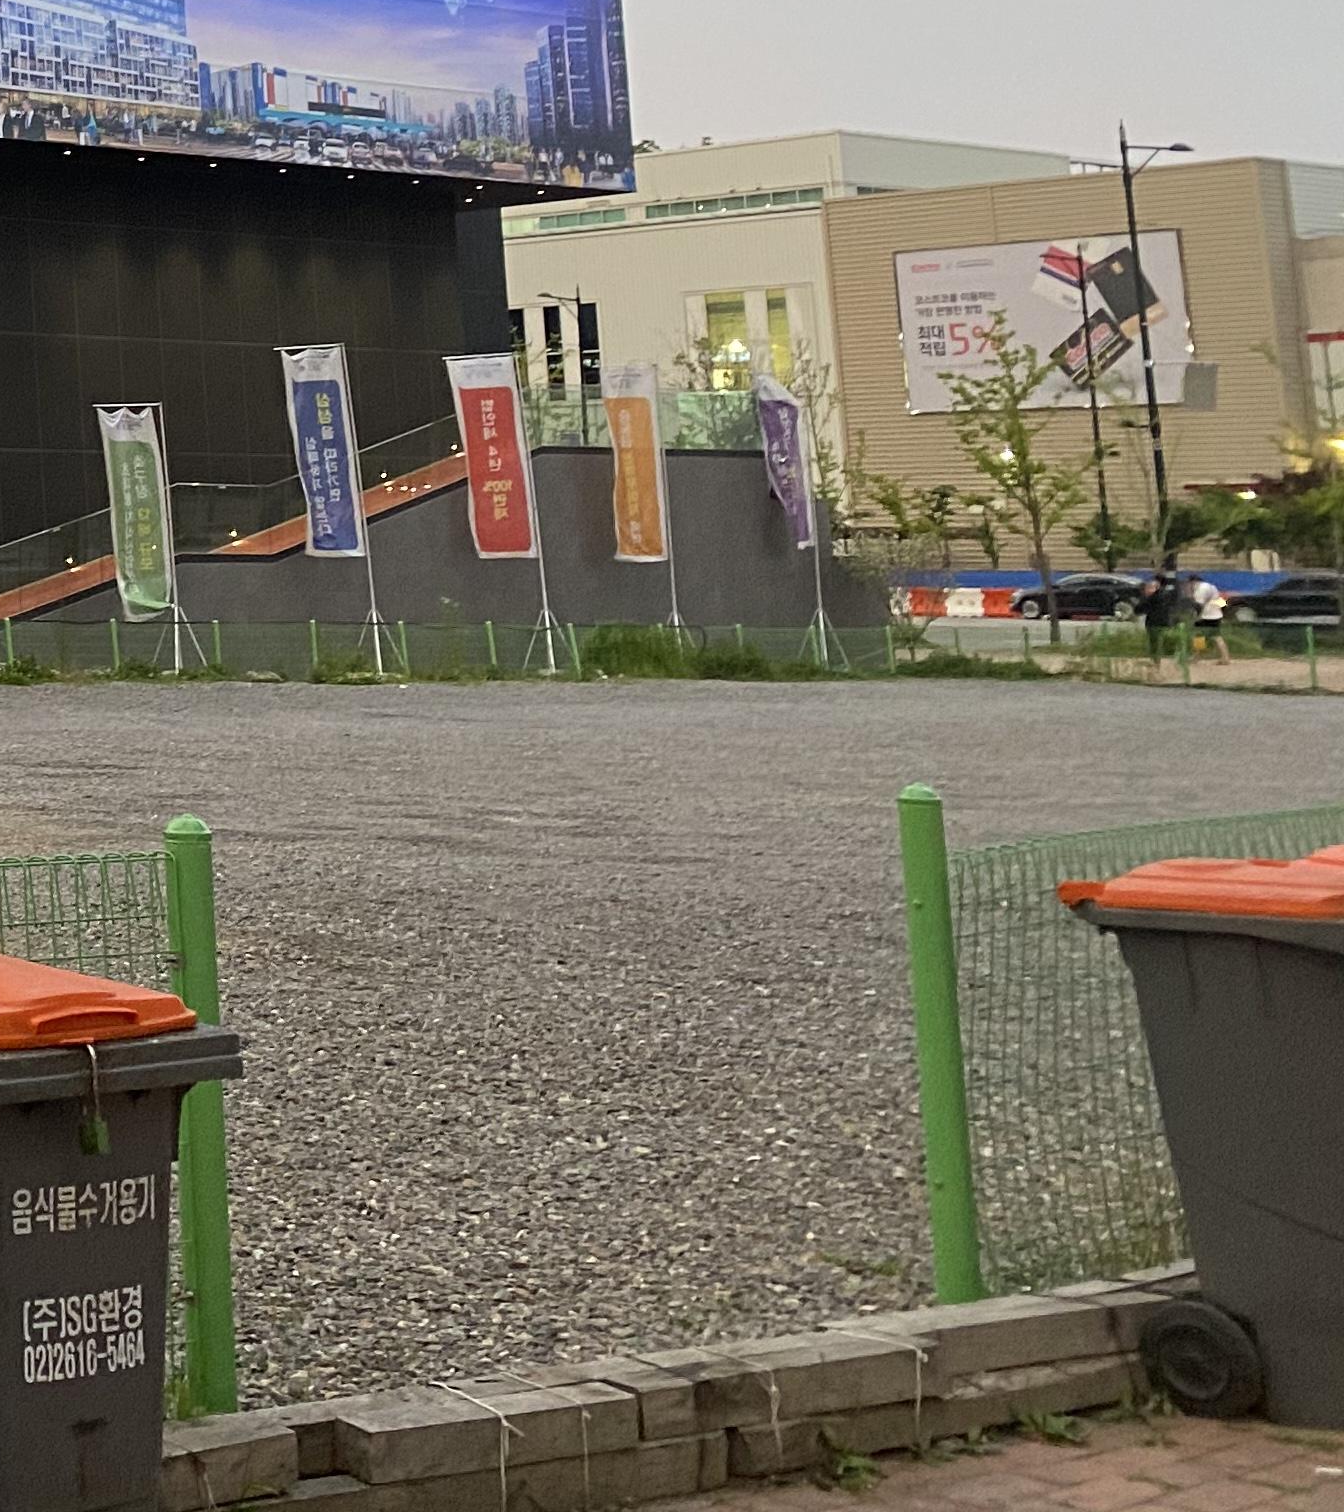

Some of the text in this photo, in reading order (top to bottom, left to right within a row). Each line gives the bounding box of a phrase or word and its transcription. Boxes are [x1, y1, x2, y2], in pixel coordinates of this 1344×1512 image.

[918, 325, 945, 339] 최대
[949, 323, 1000, 355] 5%
[920, 342, 946, 356] 적립
[12, 1174, 155, 1235] 음식물수거용기
[23, 1329, 145, 1384] 02)2616-5464
